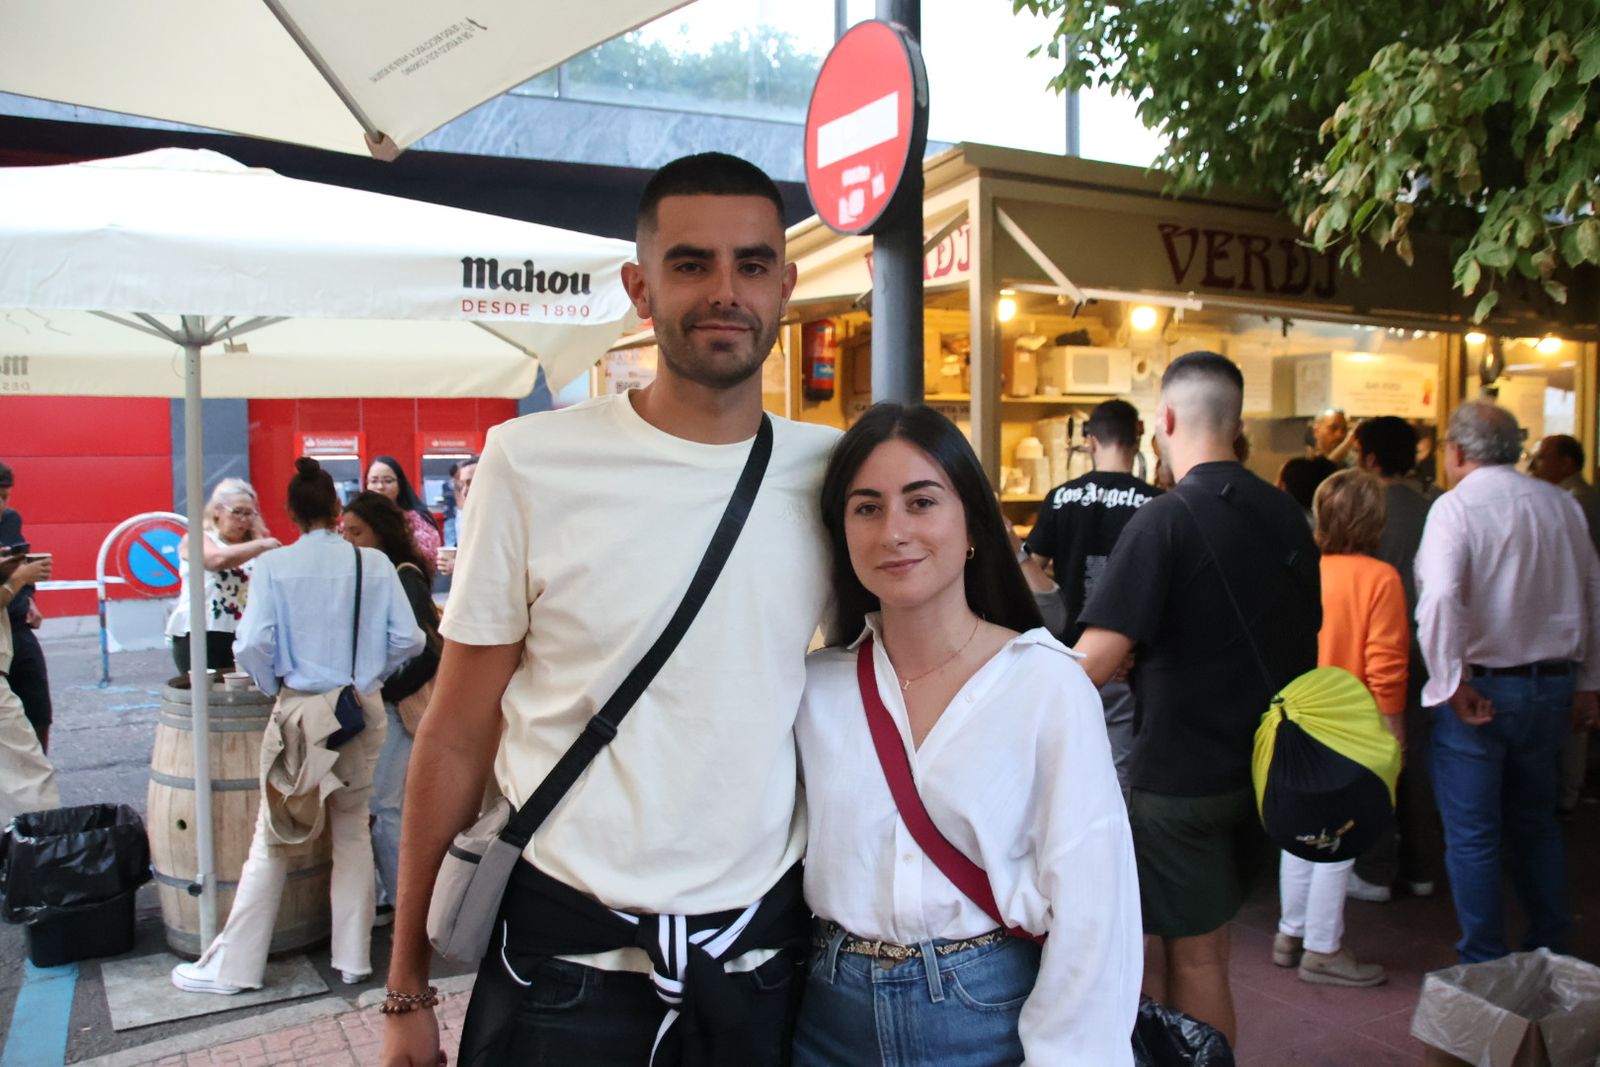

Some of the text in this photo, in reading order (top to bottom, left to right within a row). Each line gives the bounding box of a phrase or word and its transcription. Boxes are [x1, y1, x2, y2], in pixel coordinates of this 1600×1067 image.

[461, 256, 591, 295] Mahou
[462, 299, 590, 317] DESDE 1890
[1052, 486, 1083, 510] Los
